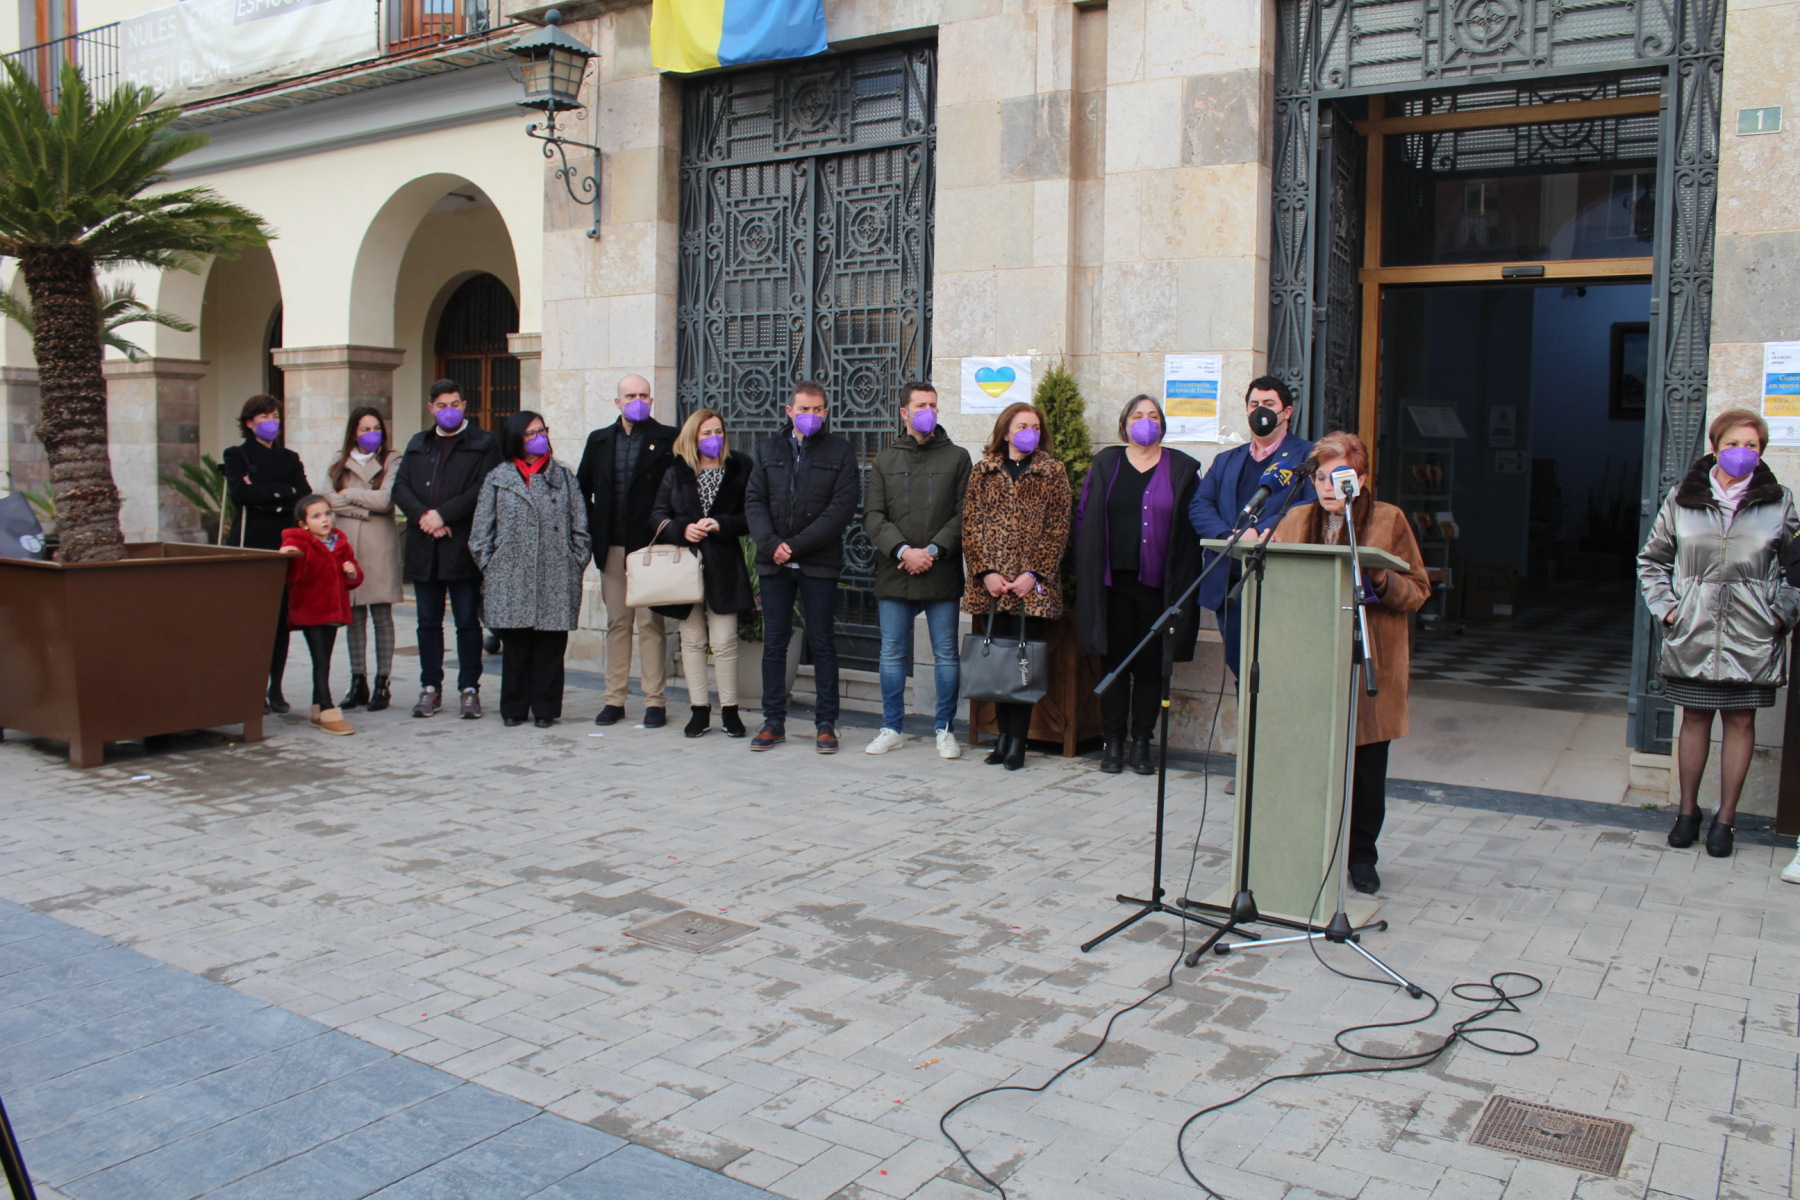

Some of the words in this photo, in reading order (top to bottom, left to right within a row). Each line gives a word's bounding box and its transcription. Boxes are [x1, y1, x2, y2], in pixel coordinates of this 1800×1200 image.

[128, 15, 177, 49] NULES
[153, 62, 175, 92] SU
[178, 49, 231, 87] PLAYA
[1756, 110, 1764, 130] 1
